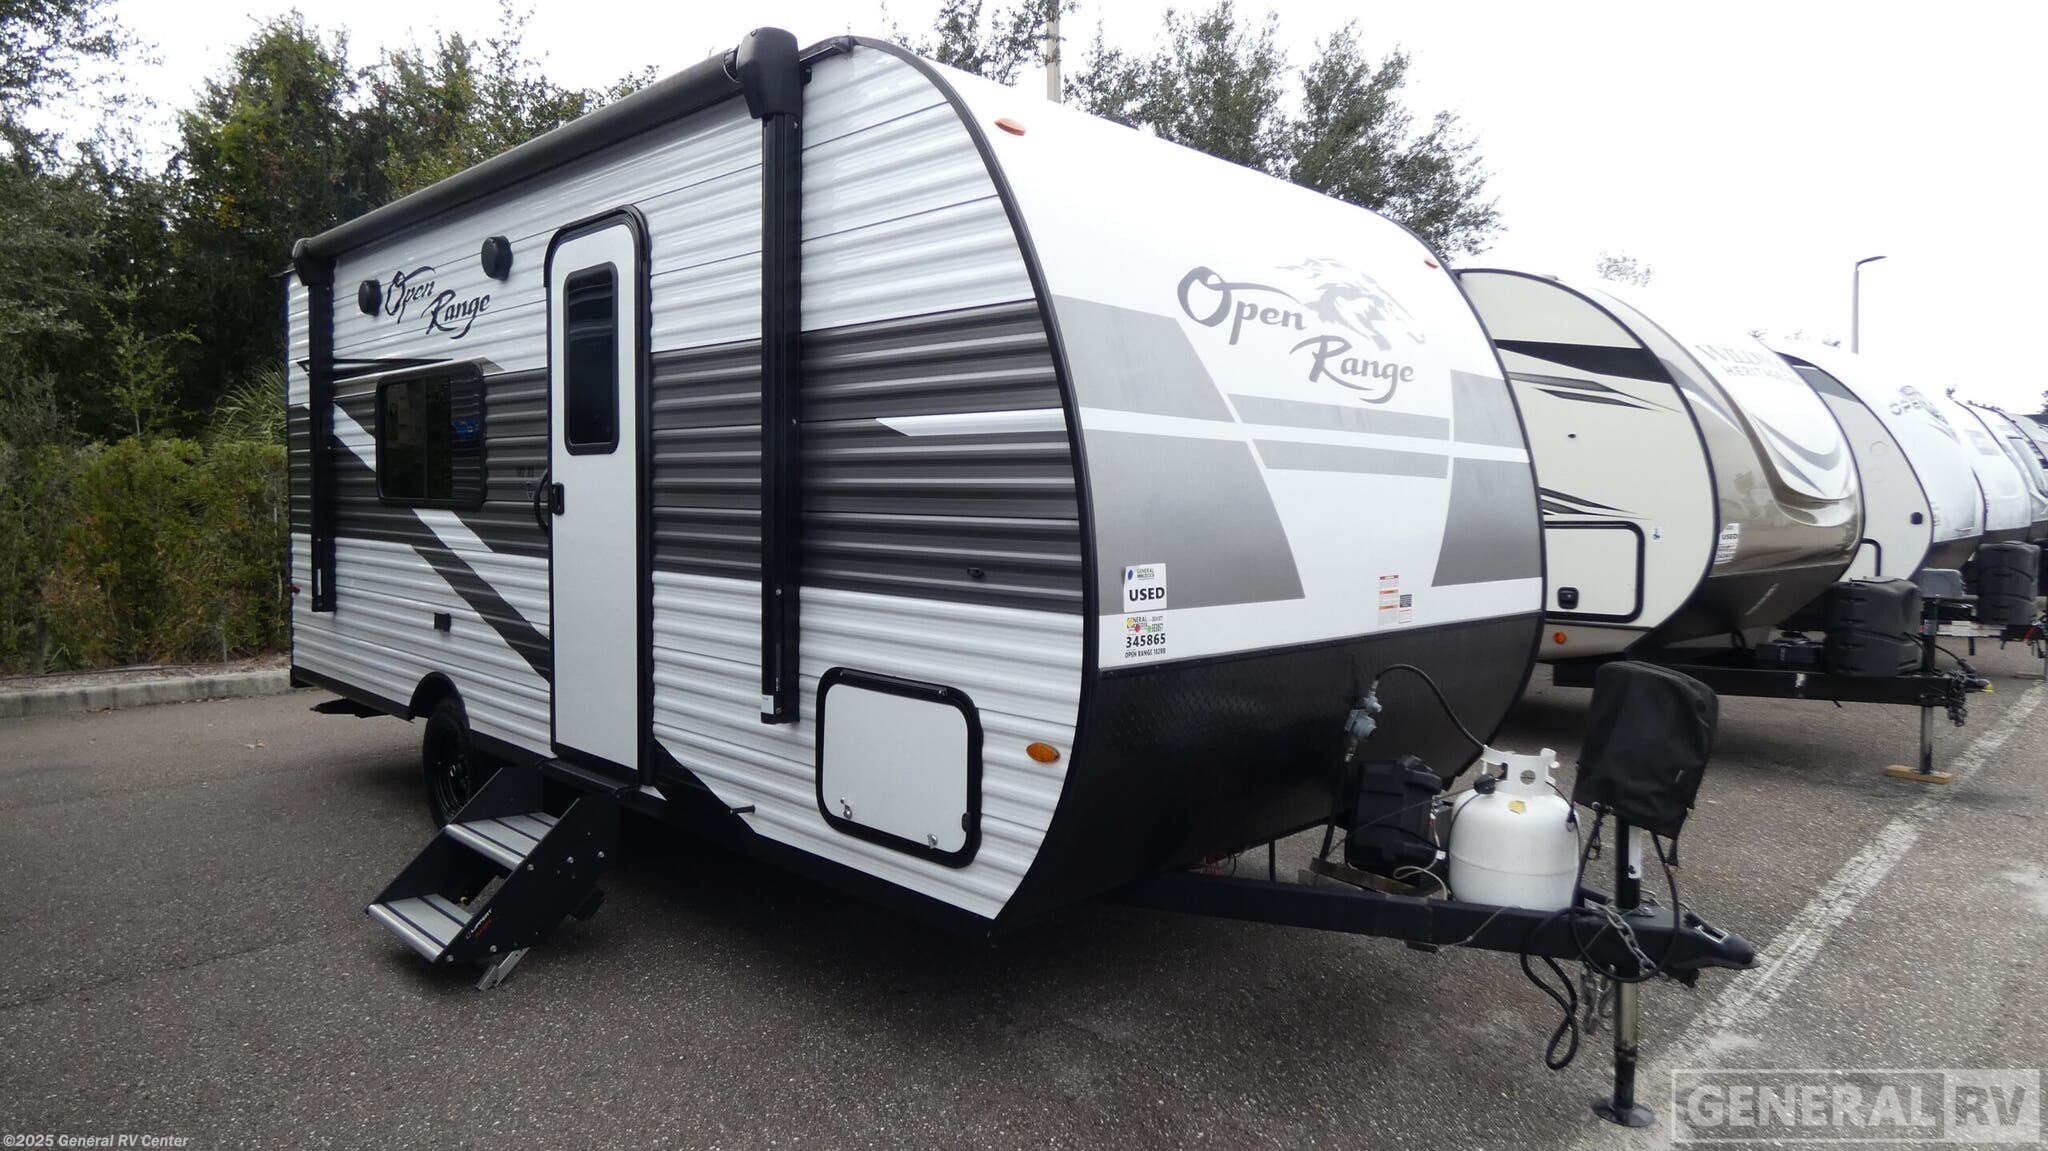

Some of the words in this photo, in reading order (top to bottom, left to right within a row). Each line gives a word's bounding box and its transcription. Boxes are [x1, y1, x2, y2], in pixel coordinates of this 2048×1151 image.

[385, 266, 436, 324] Open
[420, 289, 490, 339] Range
[1177, 266, 1306, 345] Open
[1289, 335, 1415, 404] Range
[1129, 587, 1165, 601] USED
[1126, 633, 1166, 648] 345865
